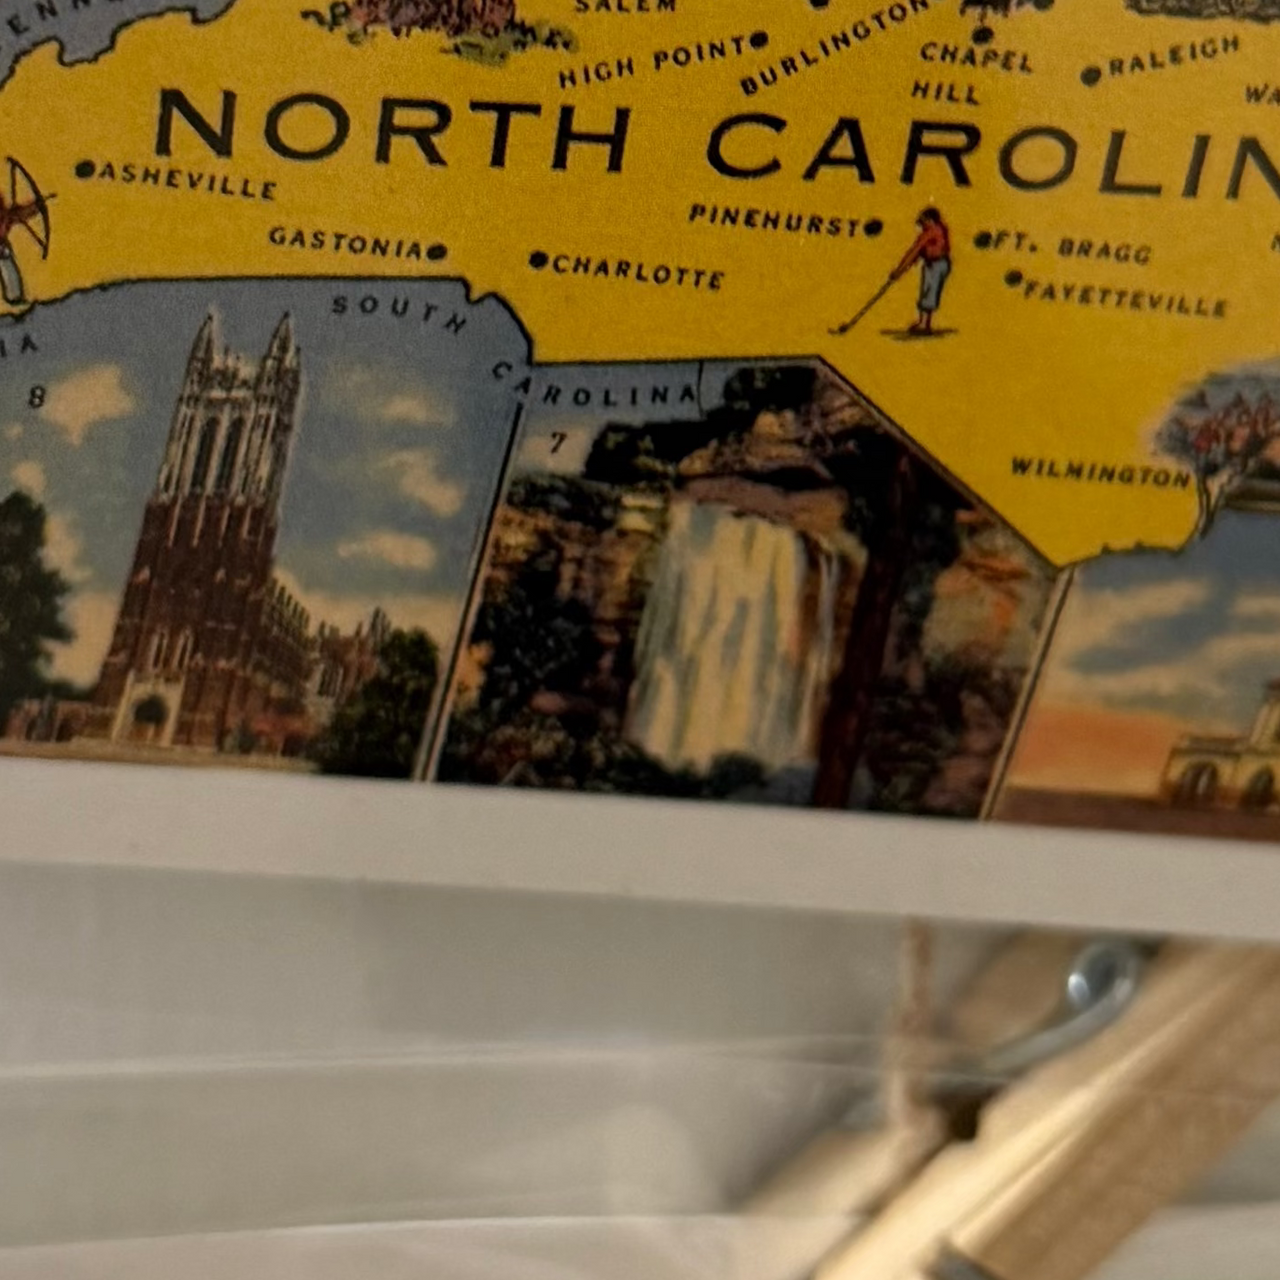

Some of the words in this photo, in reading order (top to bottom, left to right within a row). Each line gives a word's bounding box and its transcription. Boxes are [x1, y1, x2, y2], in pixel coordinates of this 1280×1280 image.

[559, 57, 635, 89] HIGH
[652, 36, 750, 72] POINT
[920, 42, 1034, 74] CHAPEL
[1108, 35, 1241, 76] RALEIGH
[912, 79, 982, 105] HILL
[155, 87, 632, 174] NORTH
[97, 161, 278, 202] ASHEVILLE
[689, 203, 862, 238] PINEHURST
[269, 226, 425, 262] GASTONIA
[991, 228, 1038, 254] FT.
[1058, 237, 1152, 265] BRAGG
[551, 254, 724, 292] CHARLOTTE
[1023, 280, 1230, 320] FAYETTEVILLE
[331, 293, 468, 335] SOUTH
[492, 360, 697, 407] CAROLINA
[28, 386, 45, 408] 8
[550, 431, 568, 455] 7
[1011, 456, 1192, 490] WILMINGTON
